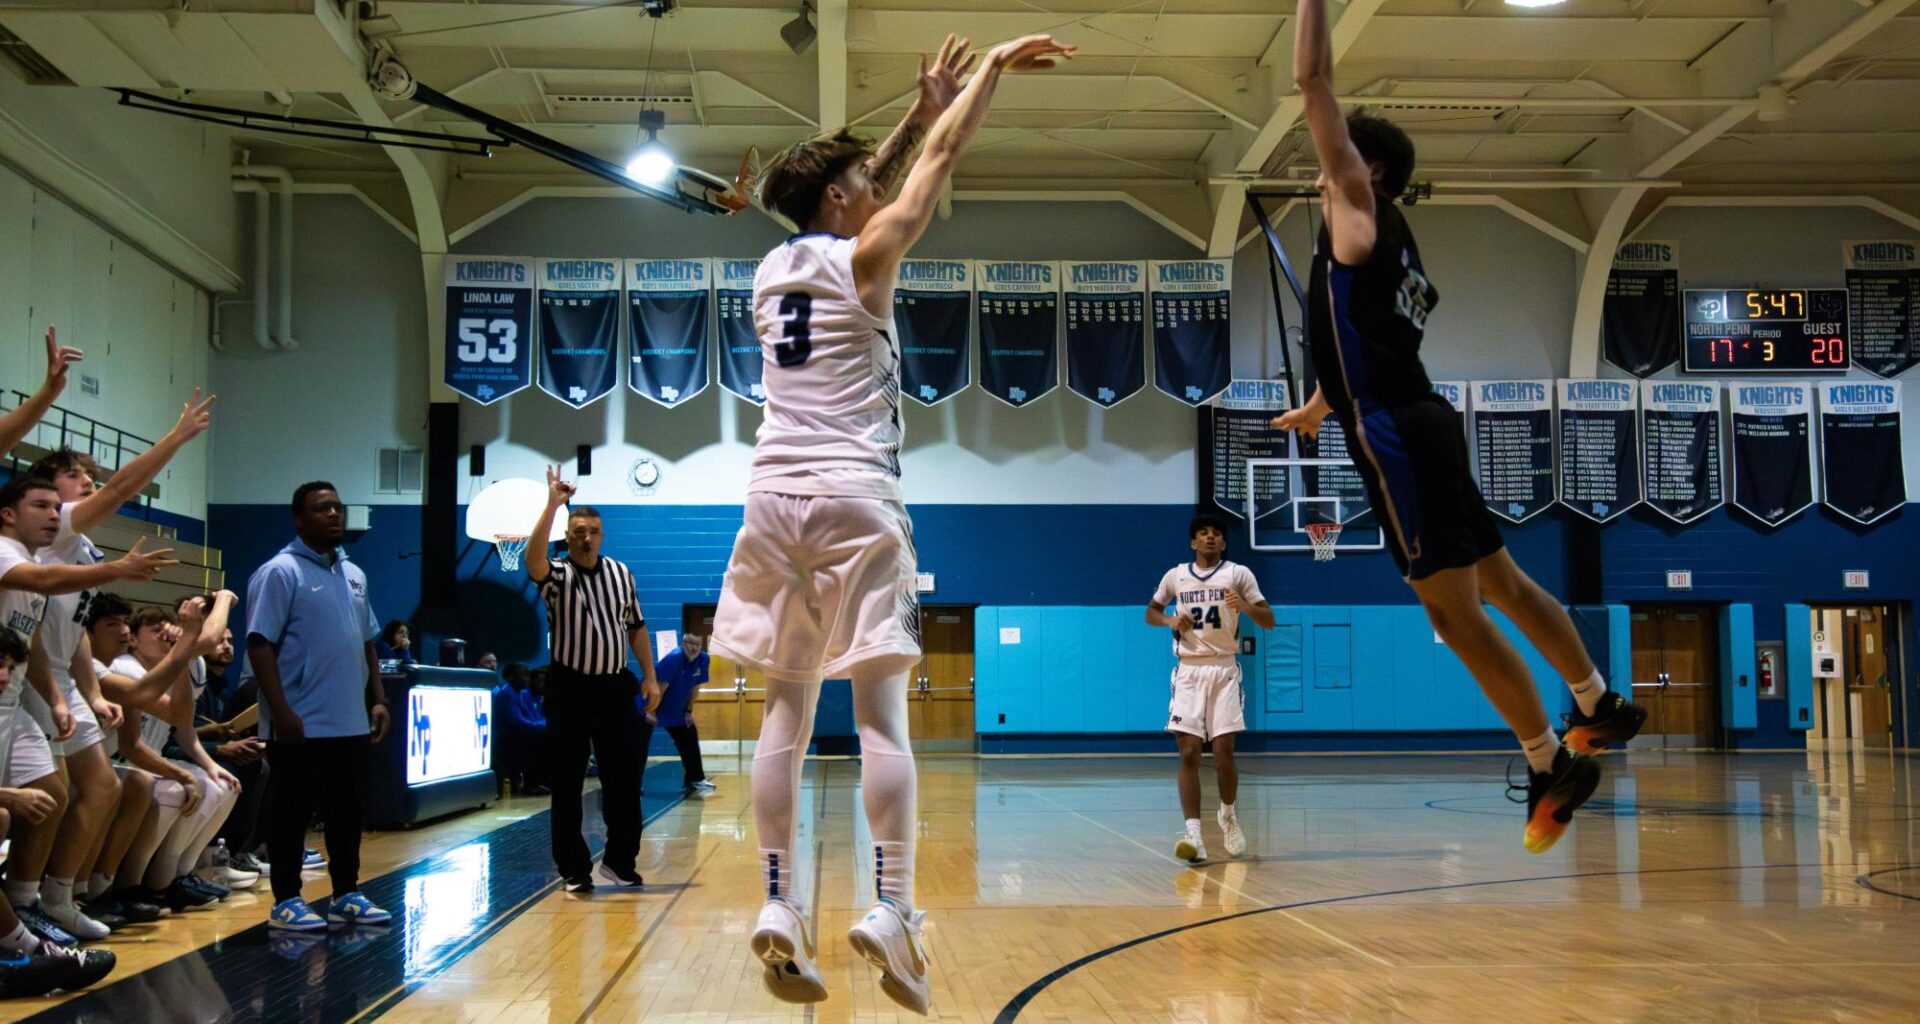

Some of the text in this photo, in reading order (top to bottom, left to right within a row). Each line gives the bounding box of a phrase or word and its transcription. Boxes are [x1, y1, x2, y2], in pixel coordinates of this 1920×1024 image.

[1615, 243, 1671, 261] NIGHTS
[1853, 243, 1915, 260] KNIGHTS
[456, 261, 525, 281] KNIGHTS
[546, 260, 615, 280] KNIGHTS
[635, 261, 703, 280] KNIGHTS
[723, 260, 759, 279] KNIG
[900, 261, 966, 282] KNIGHTS
[985, 263, 1052, 283] KNIGHTS
[1072, 263, 1138, 283] KNIGHTS
[1160, 262, 1224, 282] KNIGHTS
[464, 292, 514, 304] LINDA LAW
[1746, 292, 1802, 318] 5:47
[774, 291, 812, 368] 3
[1690, 323, 1750, 335] NORTH PENN
[1753, 330, 1781, 338] PERIOD
[1803, 323, 1842, 334] GUEST
[458, 318, 517, 363] 53
[1710, 339, 1733, 362] 17
[1763, 341, 1774, 361] 3
[1812, 339, 1843, 364] 20
[1482, 382, 1545, 402] KNIGHTS
[1568, 382, 1630, 401] KNIGHTS
[1652, 384, 1713, 403] KNIGHTS
[1739, 387, 1803, 405] KNIGHTS
[1830, 385, 1894, 403] KNIGHTS
[1180, 588, 1225, 604] NORTH PEN
[8, 610, 36, 636] BASKE
[1191, 606, 1222, 630] 24
